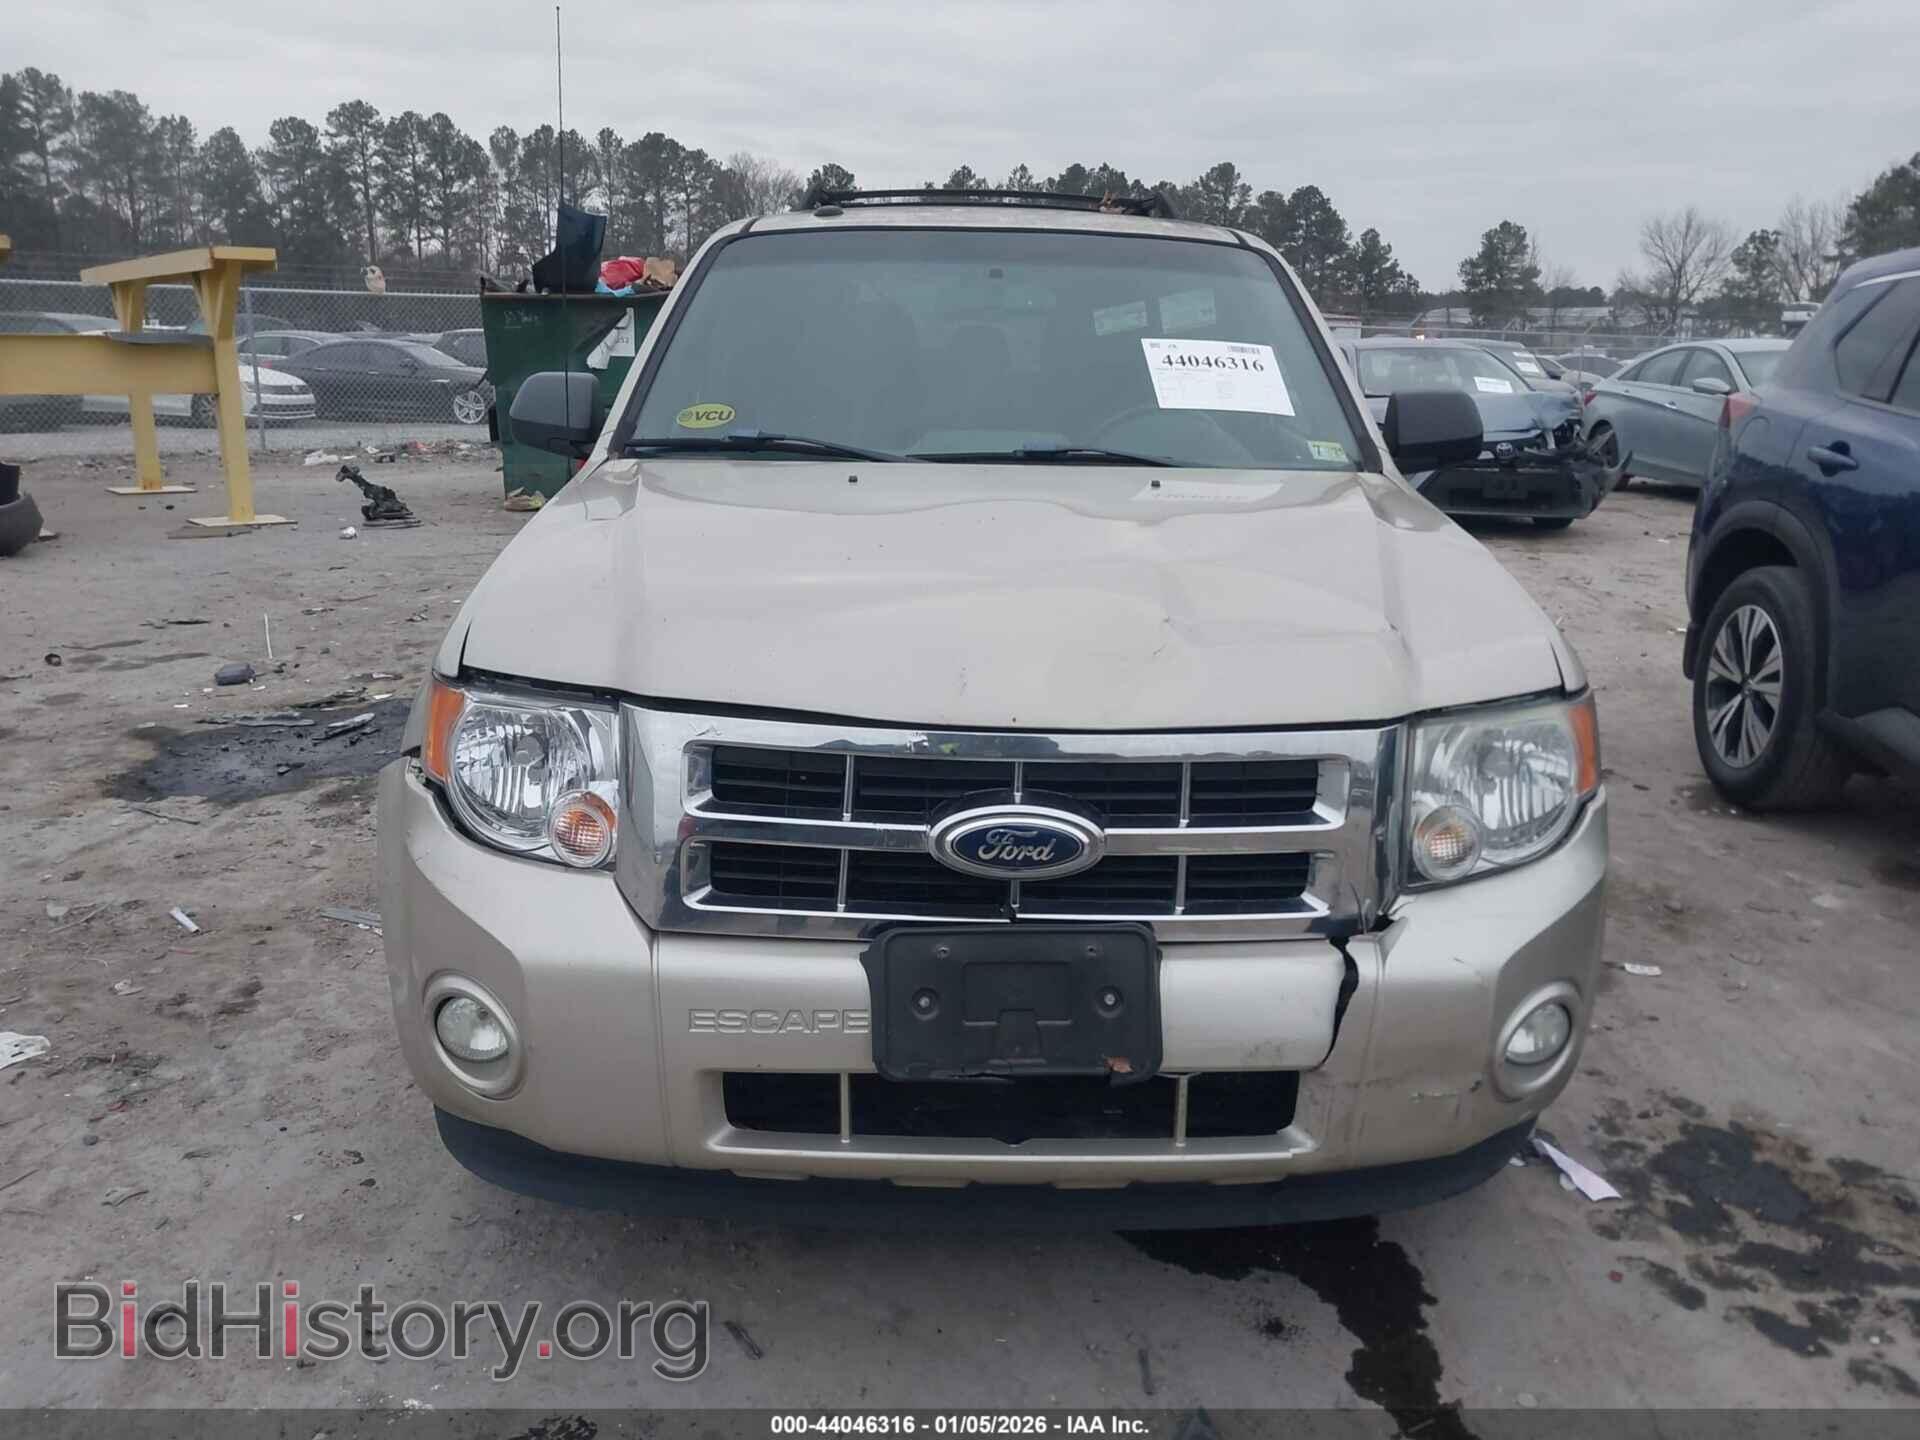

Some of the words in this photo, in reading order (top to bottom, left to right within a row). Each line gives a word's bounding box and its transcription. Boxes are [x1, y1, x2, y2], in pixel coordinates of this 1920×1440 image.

[1162, 354, 1264, 372] 44046316
[696, 410, 732, 421] VCU
[978, 828, 1056, 861] Ford
[688, 1008, 869, 1034] ESCAPE
